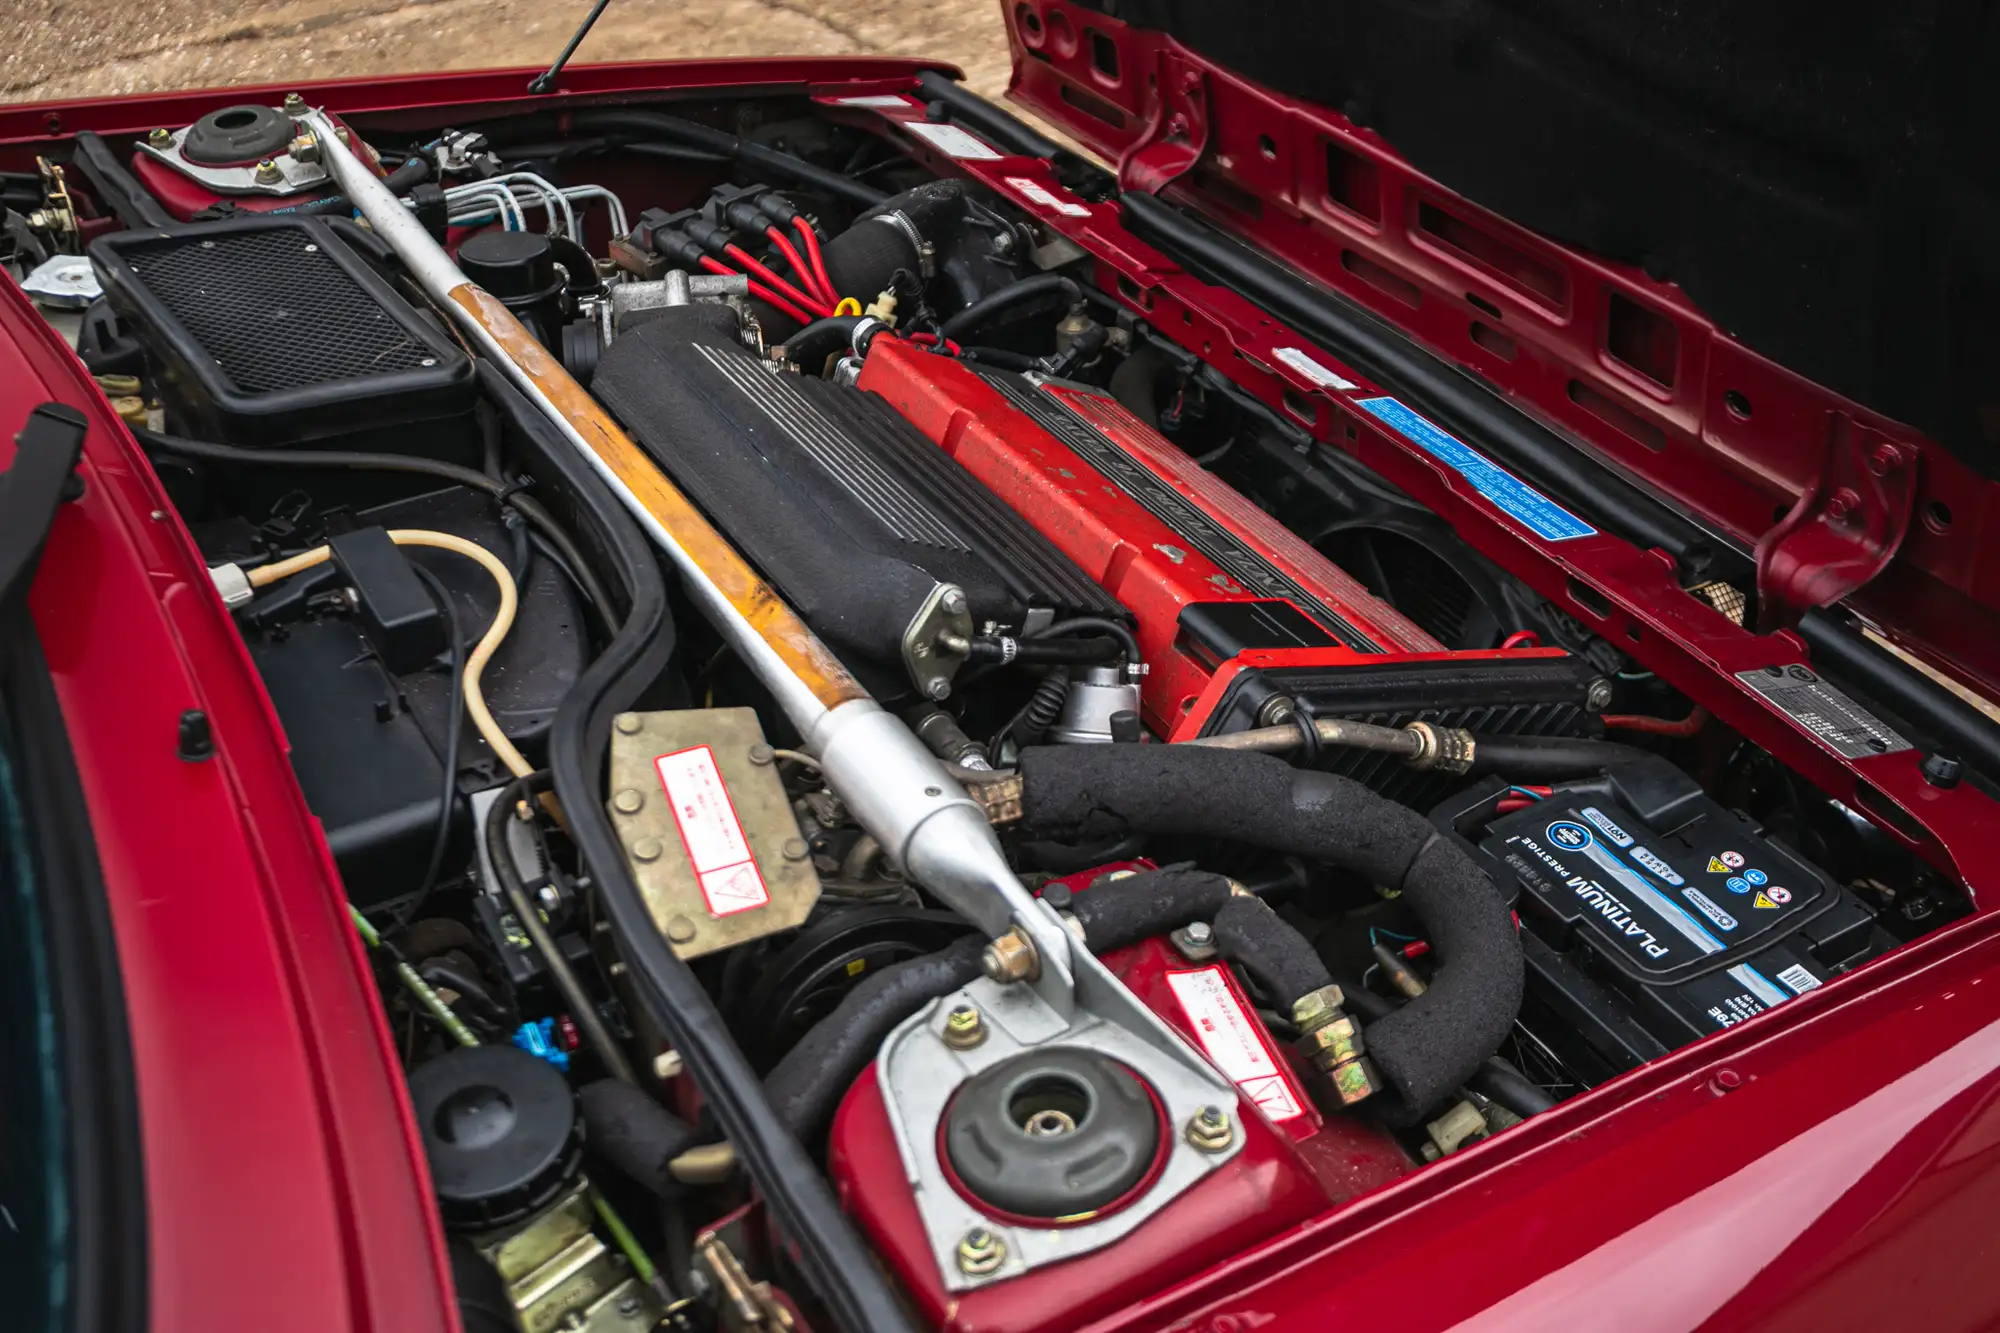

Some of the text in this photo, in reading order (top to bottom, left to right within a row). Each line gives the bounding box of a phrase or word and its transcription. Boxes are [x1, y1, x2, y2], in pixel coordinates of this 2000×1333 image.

[1146, 487, 1217, 537] TURBO
[1522, 837, 1570, 877] PRESTIGE
[1640, 855, 1671, 878] EXTRA
[1644, 853, 1674, 877] POWER
[1566, 876, 1669, 959] PLATINUM
[1734, 997, 1749, 1008] (EN)
[1742, 994, 1754, 1004] 12V
